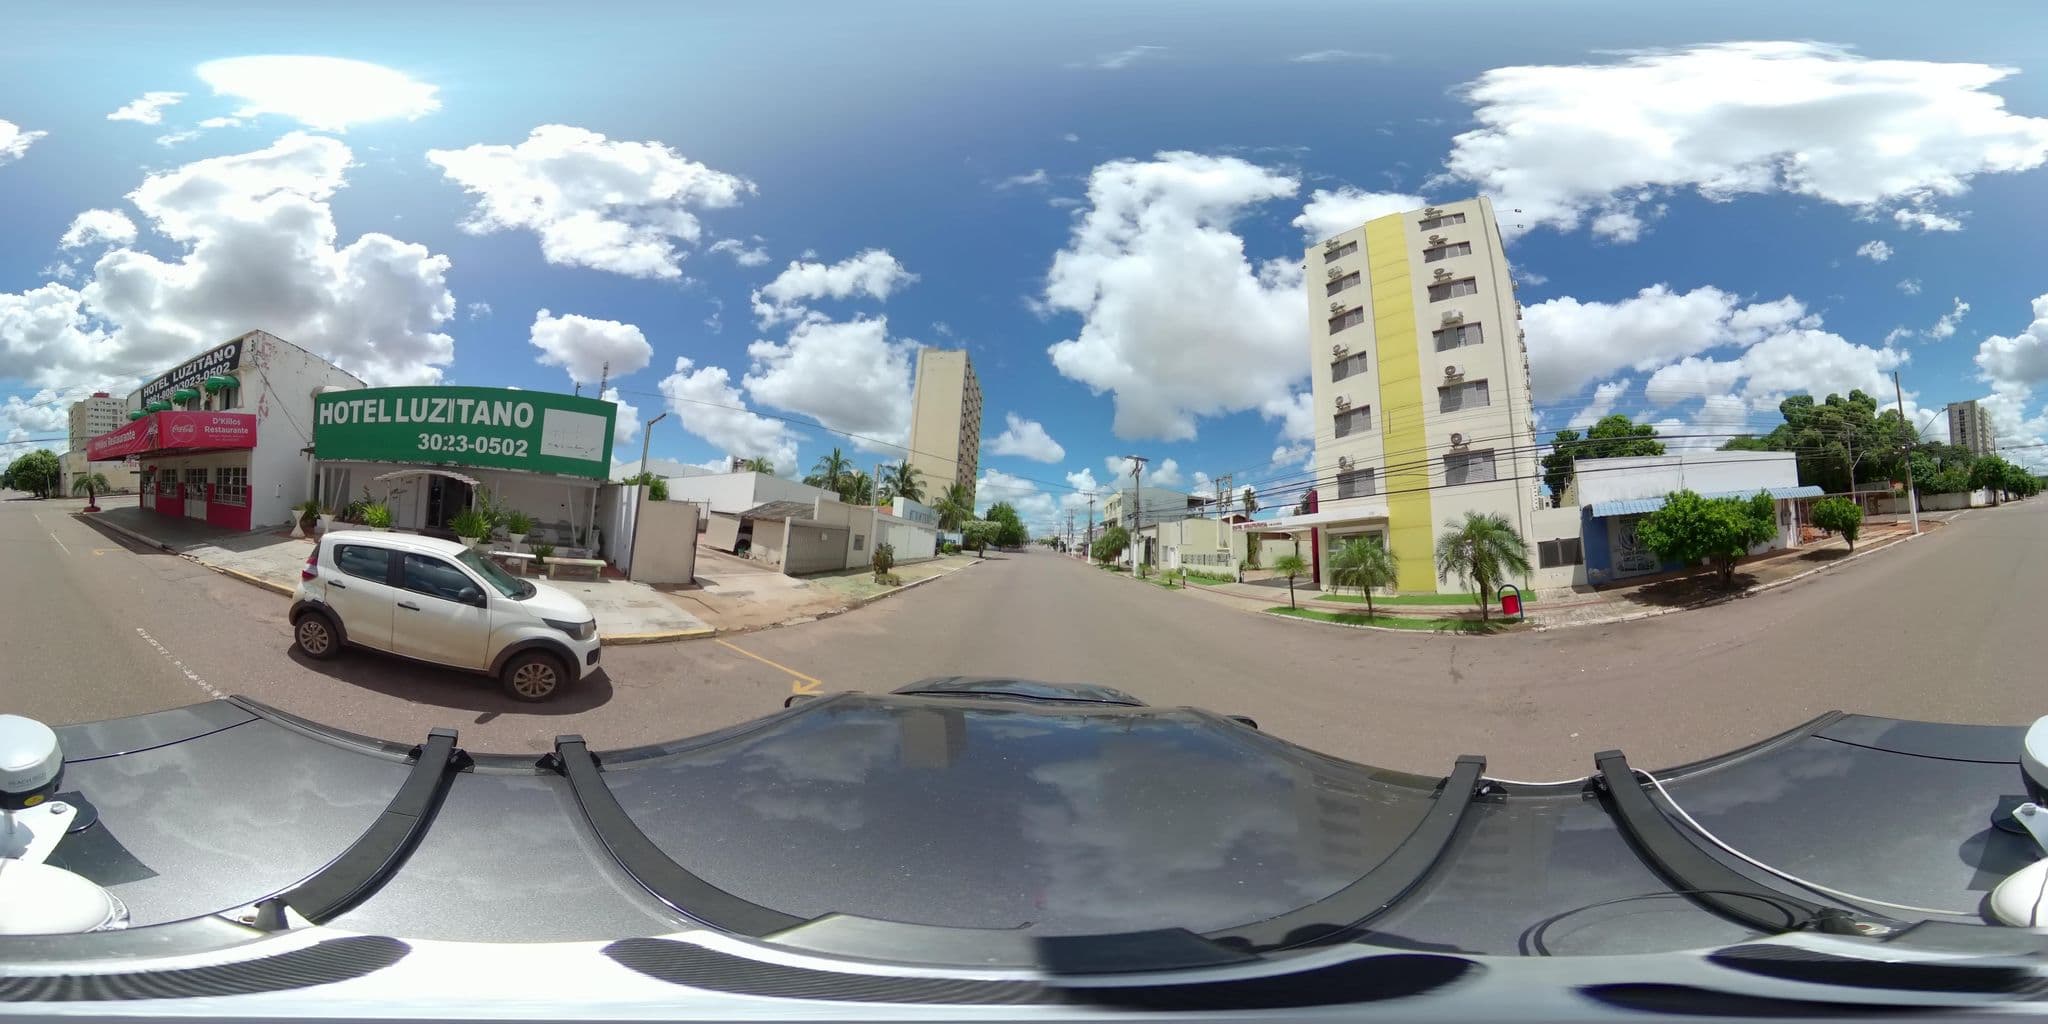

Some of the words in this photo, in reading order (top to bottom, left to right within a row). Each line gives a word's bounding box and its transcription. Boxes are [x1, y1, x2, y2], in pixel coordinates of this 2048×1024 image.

[143, 375, 170, 398] HOTEL
[172, 344, 236, 383] LUZITANO
[319, 398, 391, 425] HOTEL
[395, 398, 534, 429] LUZITANO
[204, 426, 249, 435] Restaurante
[418, 433, 529, 457] 3023-0502
